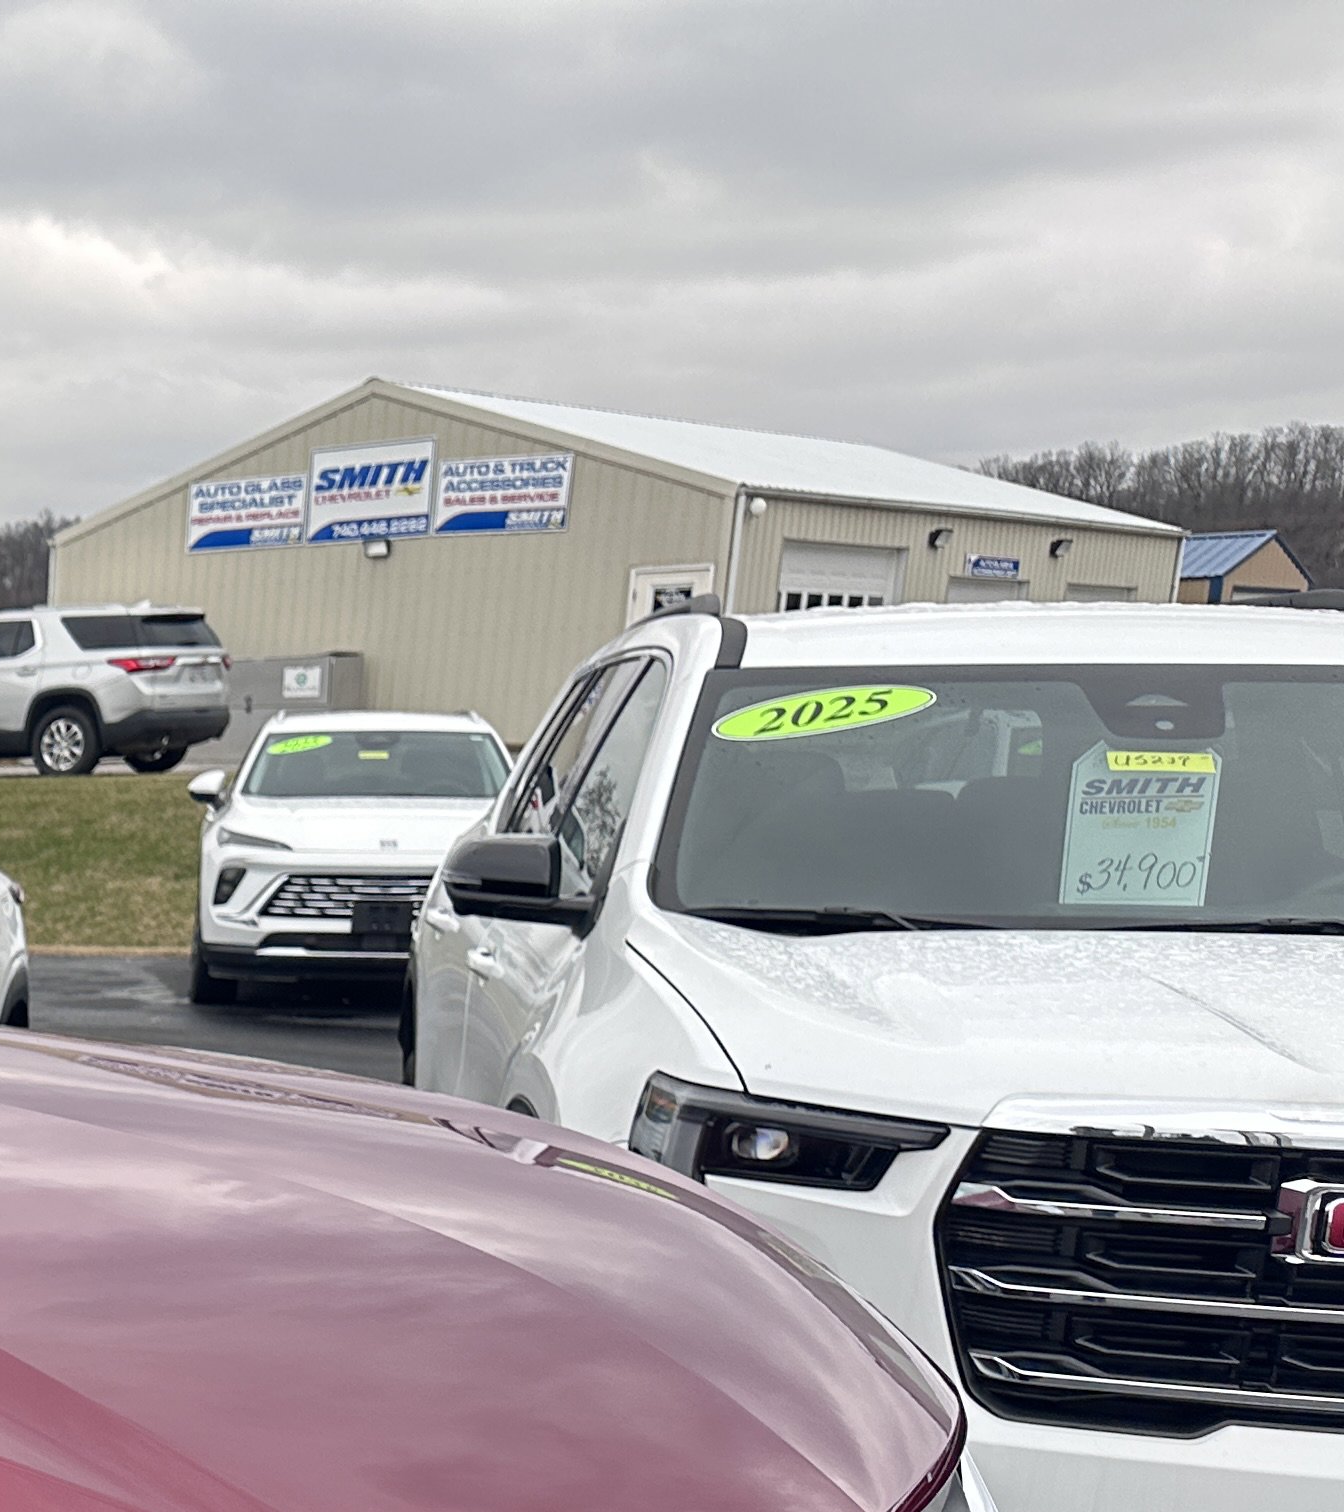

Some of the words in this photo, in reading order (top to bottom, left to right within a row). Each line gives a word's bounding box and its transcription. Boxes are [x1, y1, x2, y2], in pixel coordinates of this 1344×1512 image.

[315, 460, 429, 491] SMITH
[444, 463, 489, 477] AUTO
[493, 463, 505, 475] &
[511, 458, 568, 473] TRUCK
[194, 482, 242, 498] AUTO
[244, 478, 303, 495] GLASS
[444, 474, 564, 493] ACCESSORIES
[198, 494, 297, 513] SPECIALIST
[314, 489, 391, 505] CHEVROLET
[443, 494, 487, 507] SALES
[500, 490, 560, 503] SERVICE
[753, 689, 894, 737] 2025
[1081, 777, 1207, 796] SMITH
[1079, 799, 1164, 815] CHEVROLET
[1145, 816, 1178, 829] 1954
[1076, 853, 1197, 895] $34,900
